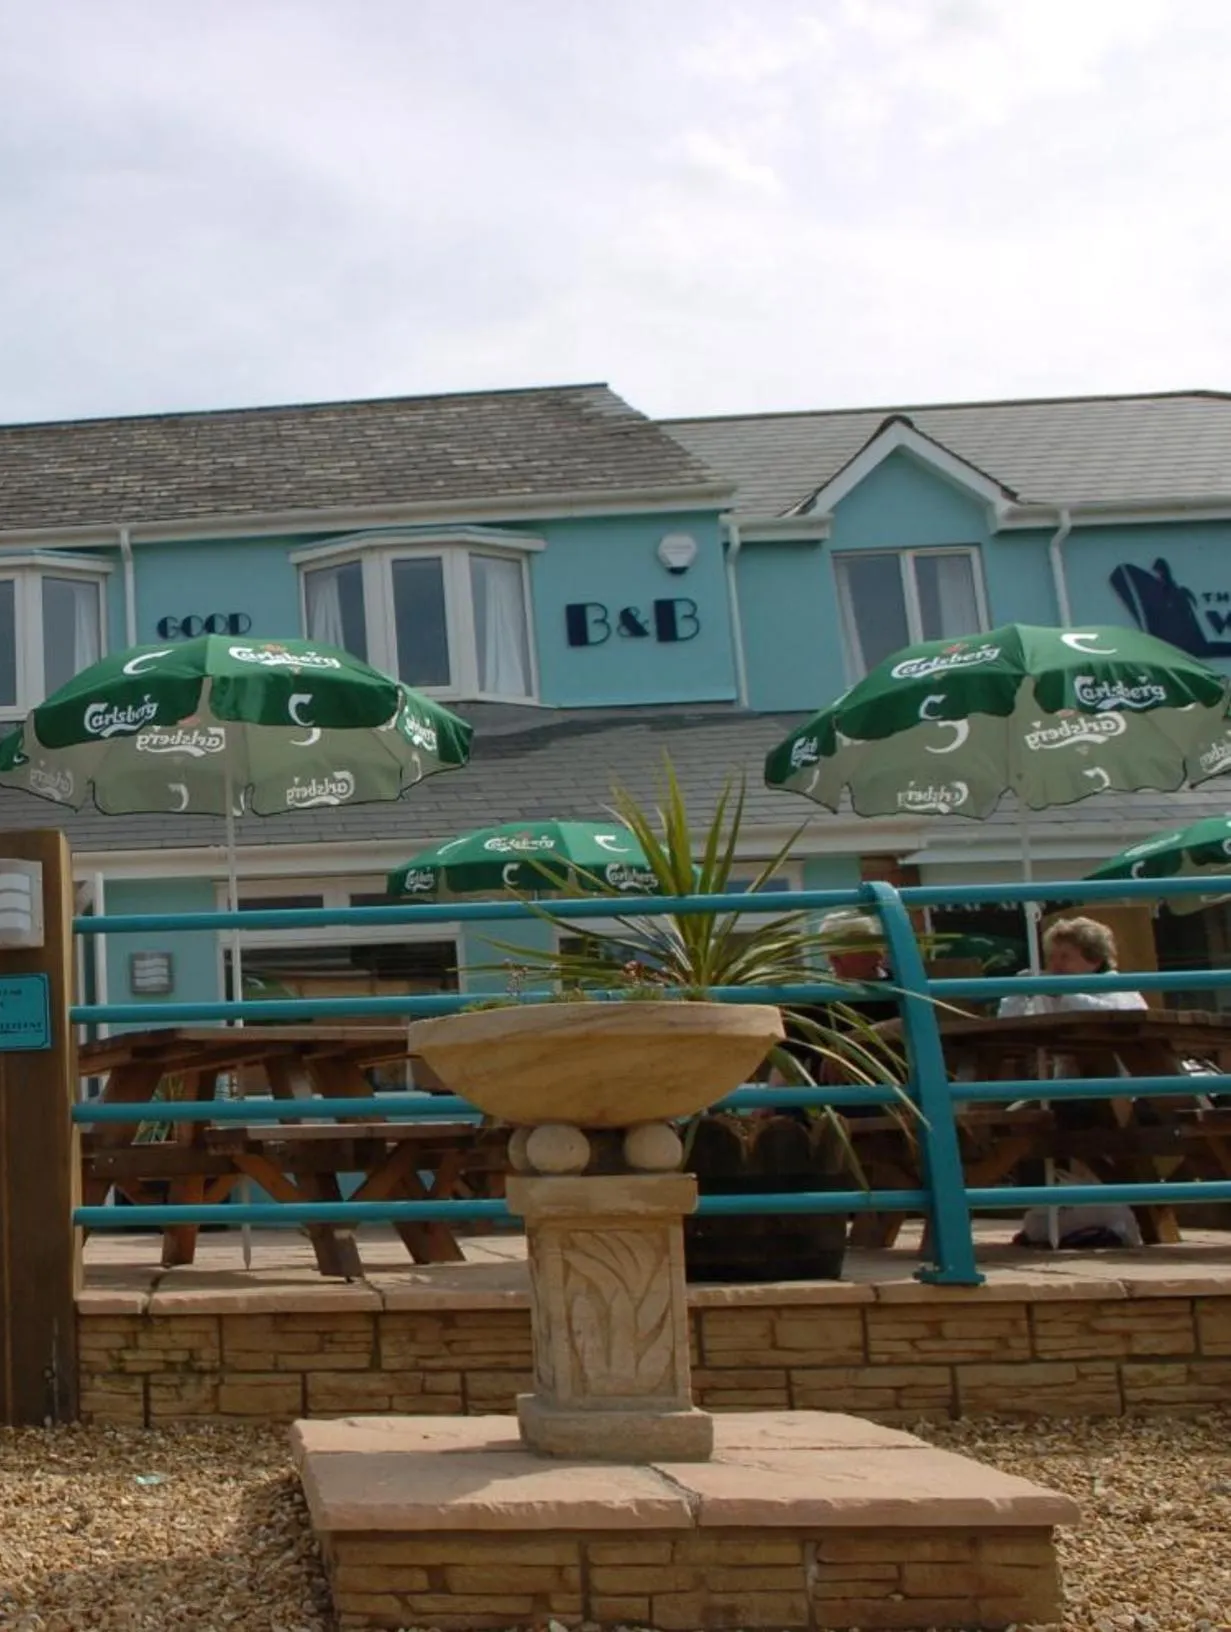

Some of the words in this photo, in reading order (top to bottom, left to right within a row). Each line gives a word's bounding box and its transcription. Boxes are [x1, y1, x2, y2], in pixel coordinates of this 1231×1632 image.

[158, 612, 252, 640] GOOD
[566, 598, 701, 647] B&B
[891, 644, 1001, 679] Carlsberg
[1074, 676, 1167, 710] Carlsberg
[84, 694, 159, 738] Carlsberg
